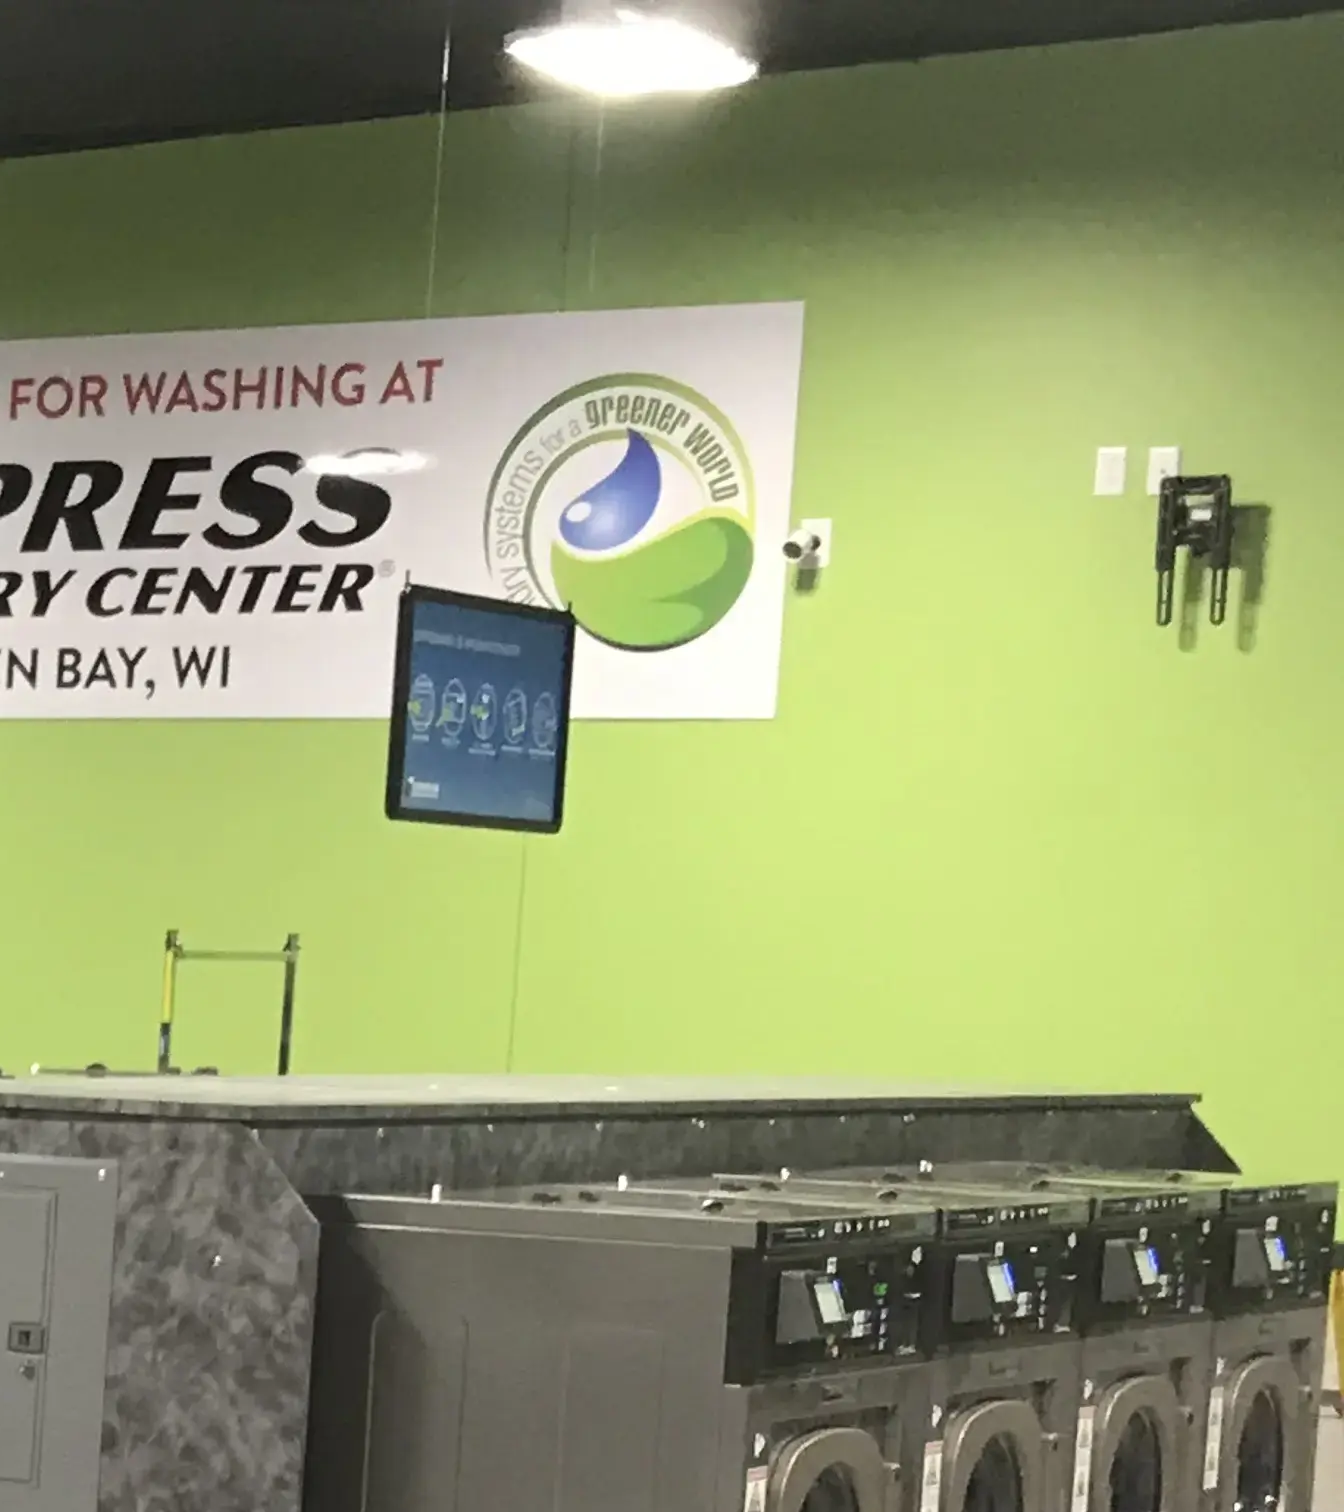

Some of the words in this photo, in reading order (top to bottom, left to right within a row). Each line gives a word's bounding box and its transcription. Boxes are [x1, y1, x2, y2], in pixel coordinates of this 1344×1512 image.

[10, 374, 108, 421] FOR
[123, 362, 367, 416] WASHING
[378, 358, 444, 404] AT
[495, 448, 545, 559] systems
[539, 427, 564, 456] for
[568, 418, 583, 437] a
[584, 393, 692, 435] greener
[56, 645, 156, 700] BAY,
[173, 645, 231, 689] WI
